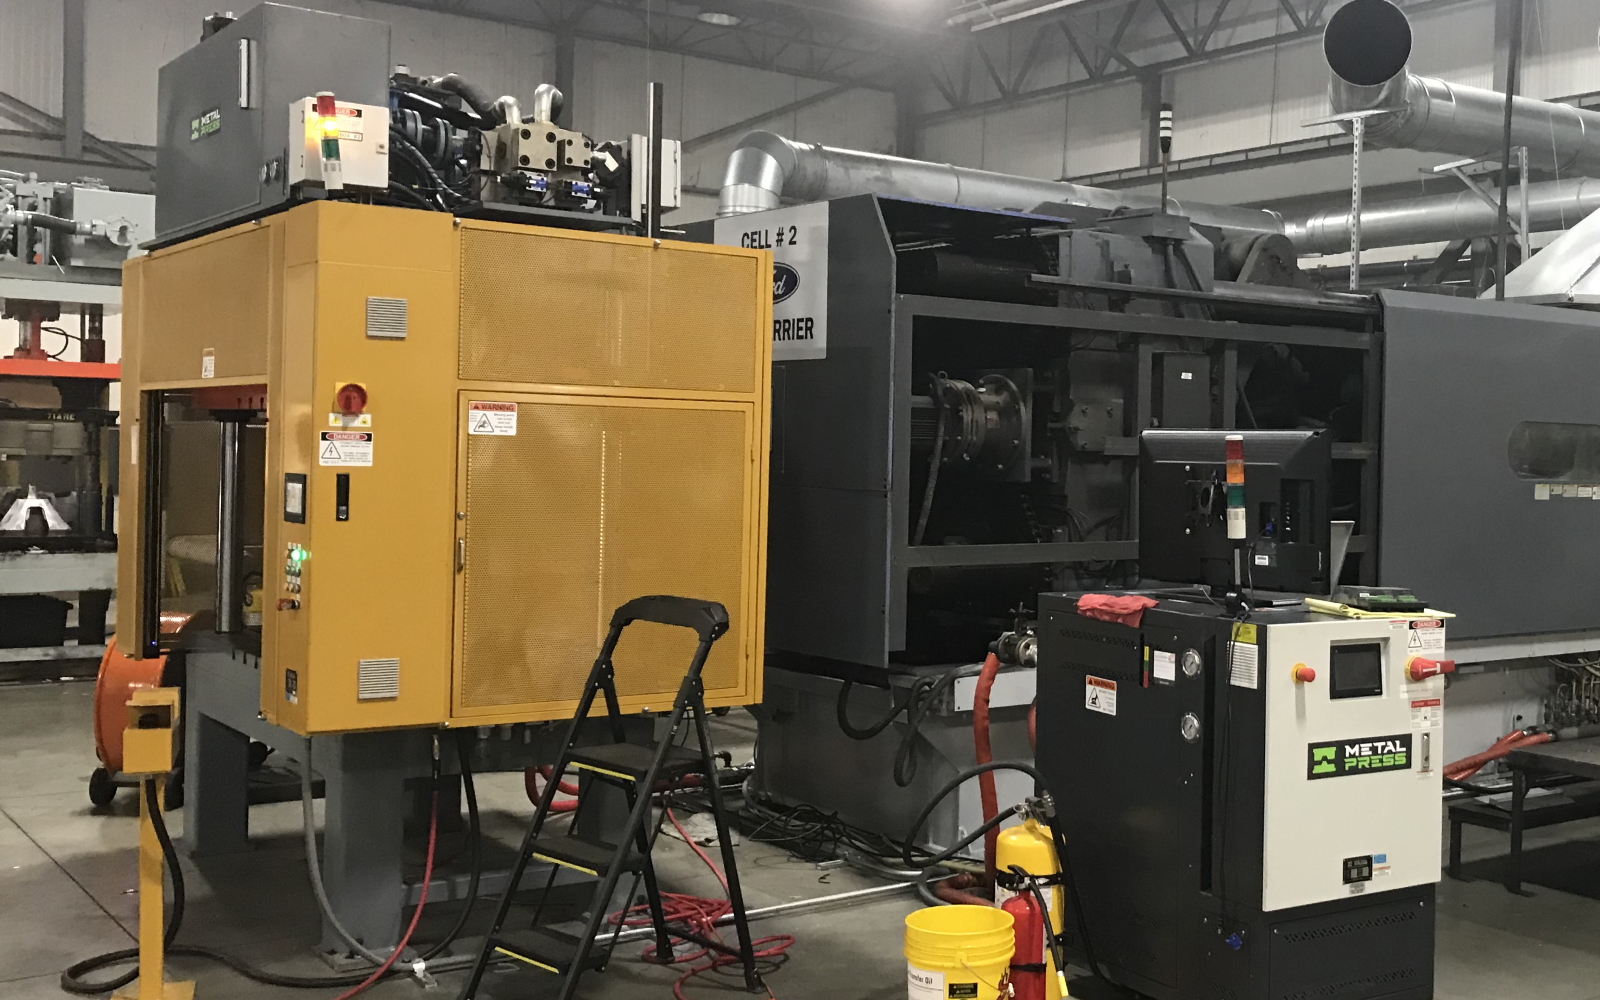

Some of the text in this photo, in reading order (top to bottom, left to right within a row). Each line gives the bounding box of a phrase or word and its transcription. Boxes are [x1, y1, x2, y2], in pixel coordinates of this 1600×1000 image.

[201, 109, 220, 126] METAL
[741, 225, 797, 249] CELL # 2
[481, 403, 515, 411] WARNING
[1344, 740, 1407, 758] METAL
[1344, 752, 1407, 771] PRESS
[924, 976, 933, 985] Oil
